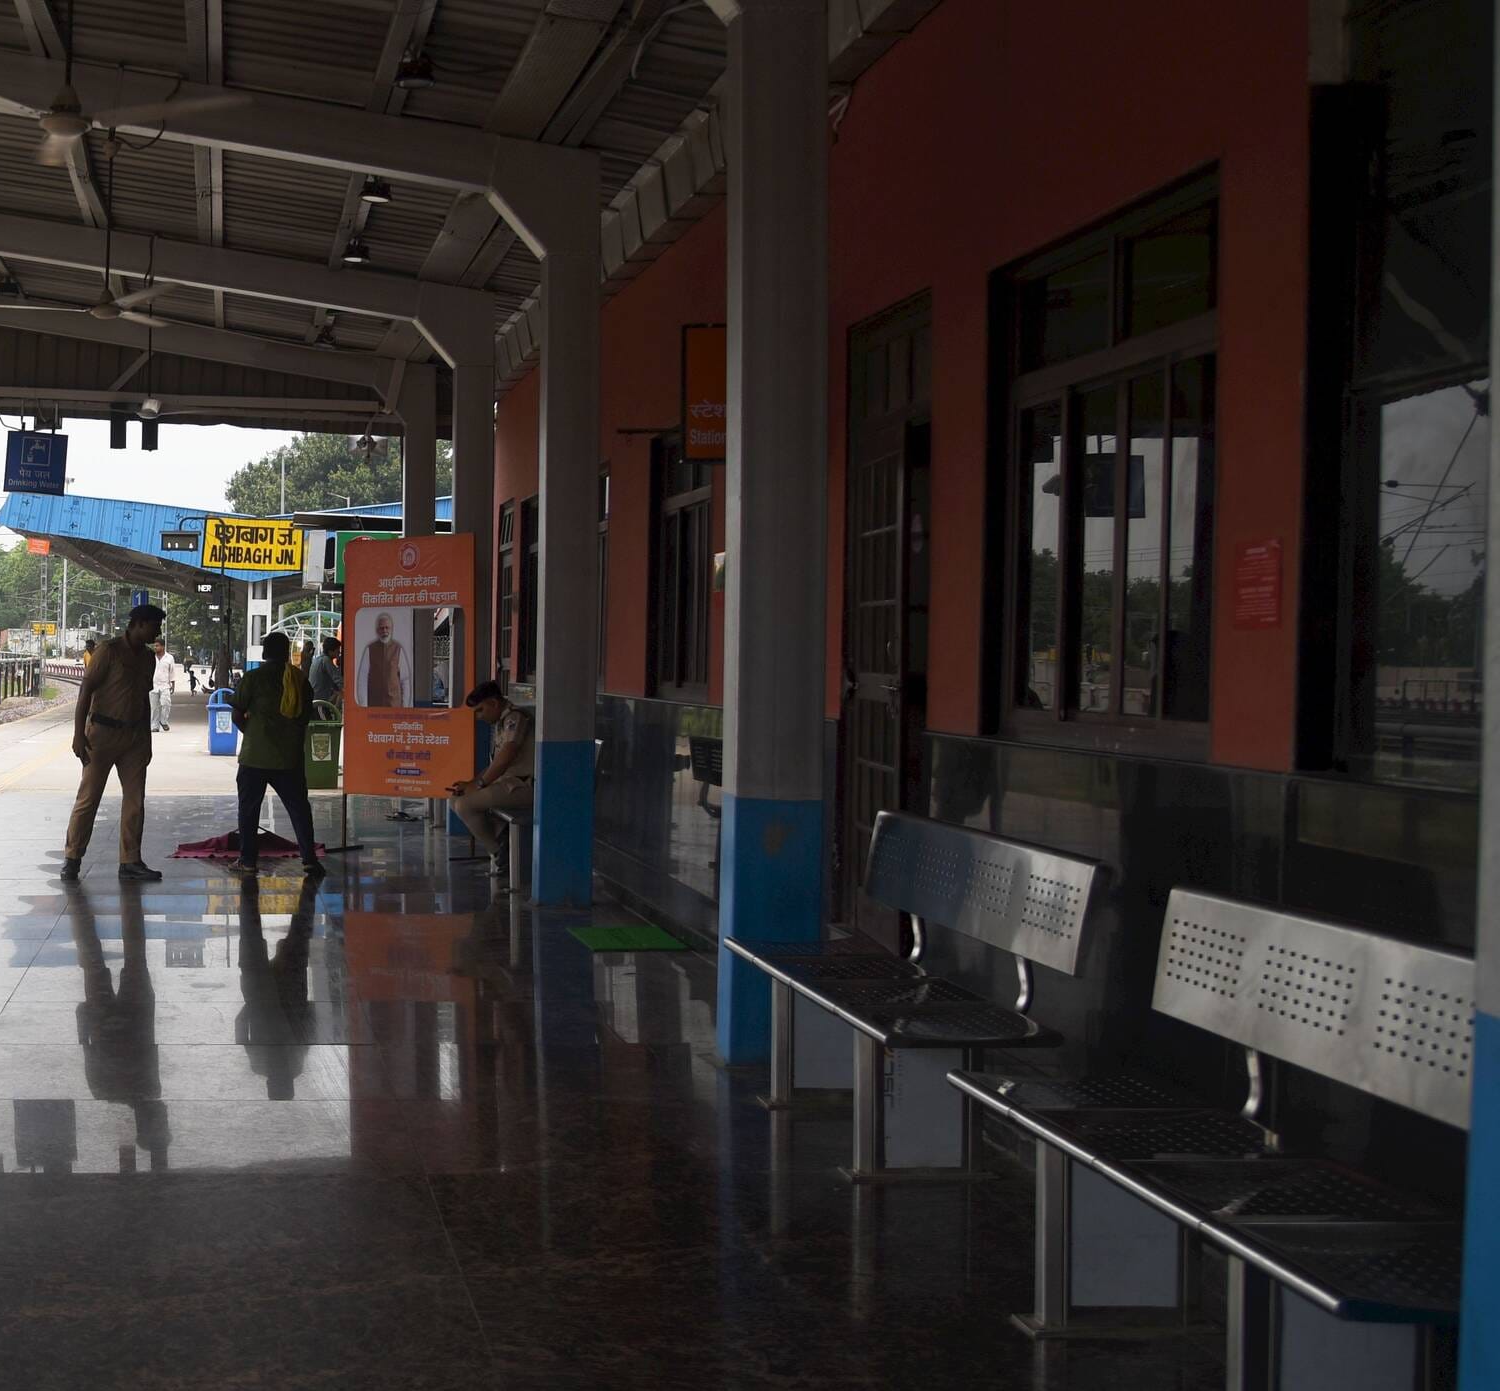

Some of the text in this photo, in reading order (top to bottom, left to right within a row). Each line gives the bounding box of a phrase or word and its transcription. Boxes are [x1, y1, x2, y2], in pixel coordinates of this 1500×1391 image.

[690, 400, 726, 418] स्टेश
[19, 467, 50, 480] पेय जल
[8, 478, 60, 489] Drinking Water
[209, 545, 296, 566] AISHBAGH JN.
[378, 575, 412, 591] आधुनिक
[135, 592, 141, 606] 1
[362, 589, 458, 604] विकसित भारत की पहचान
